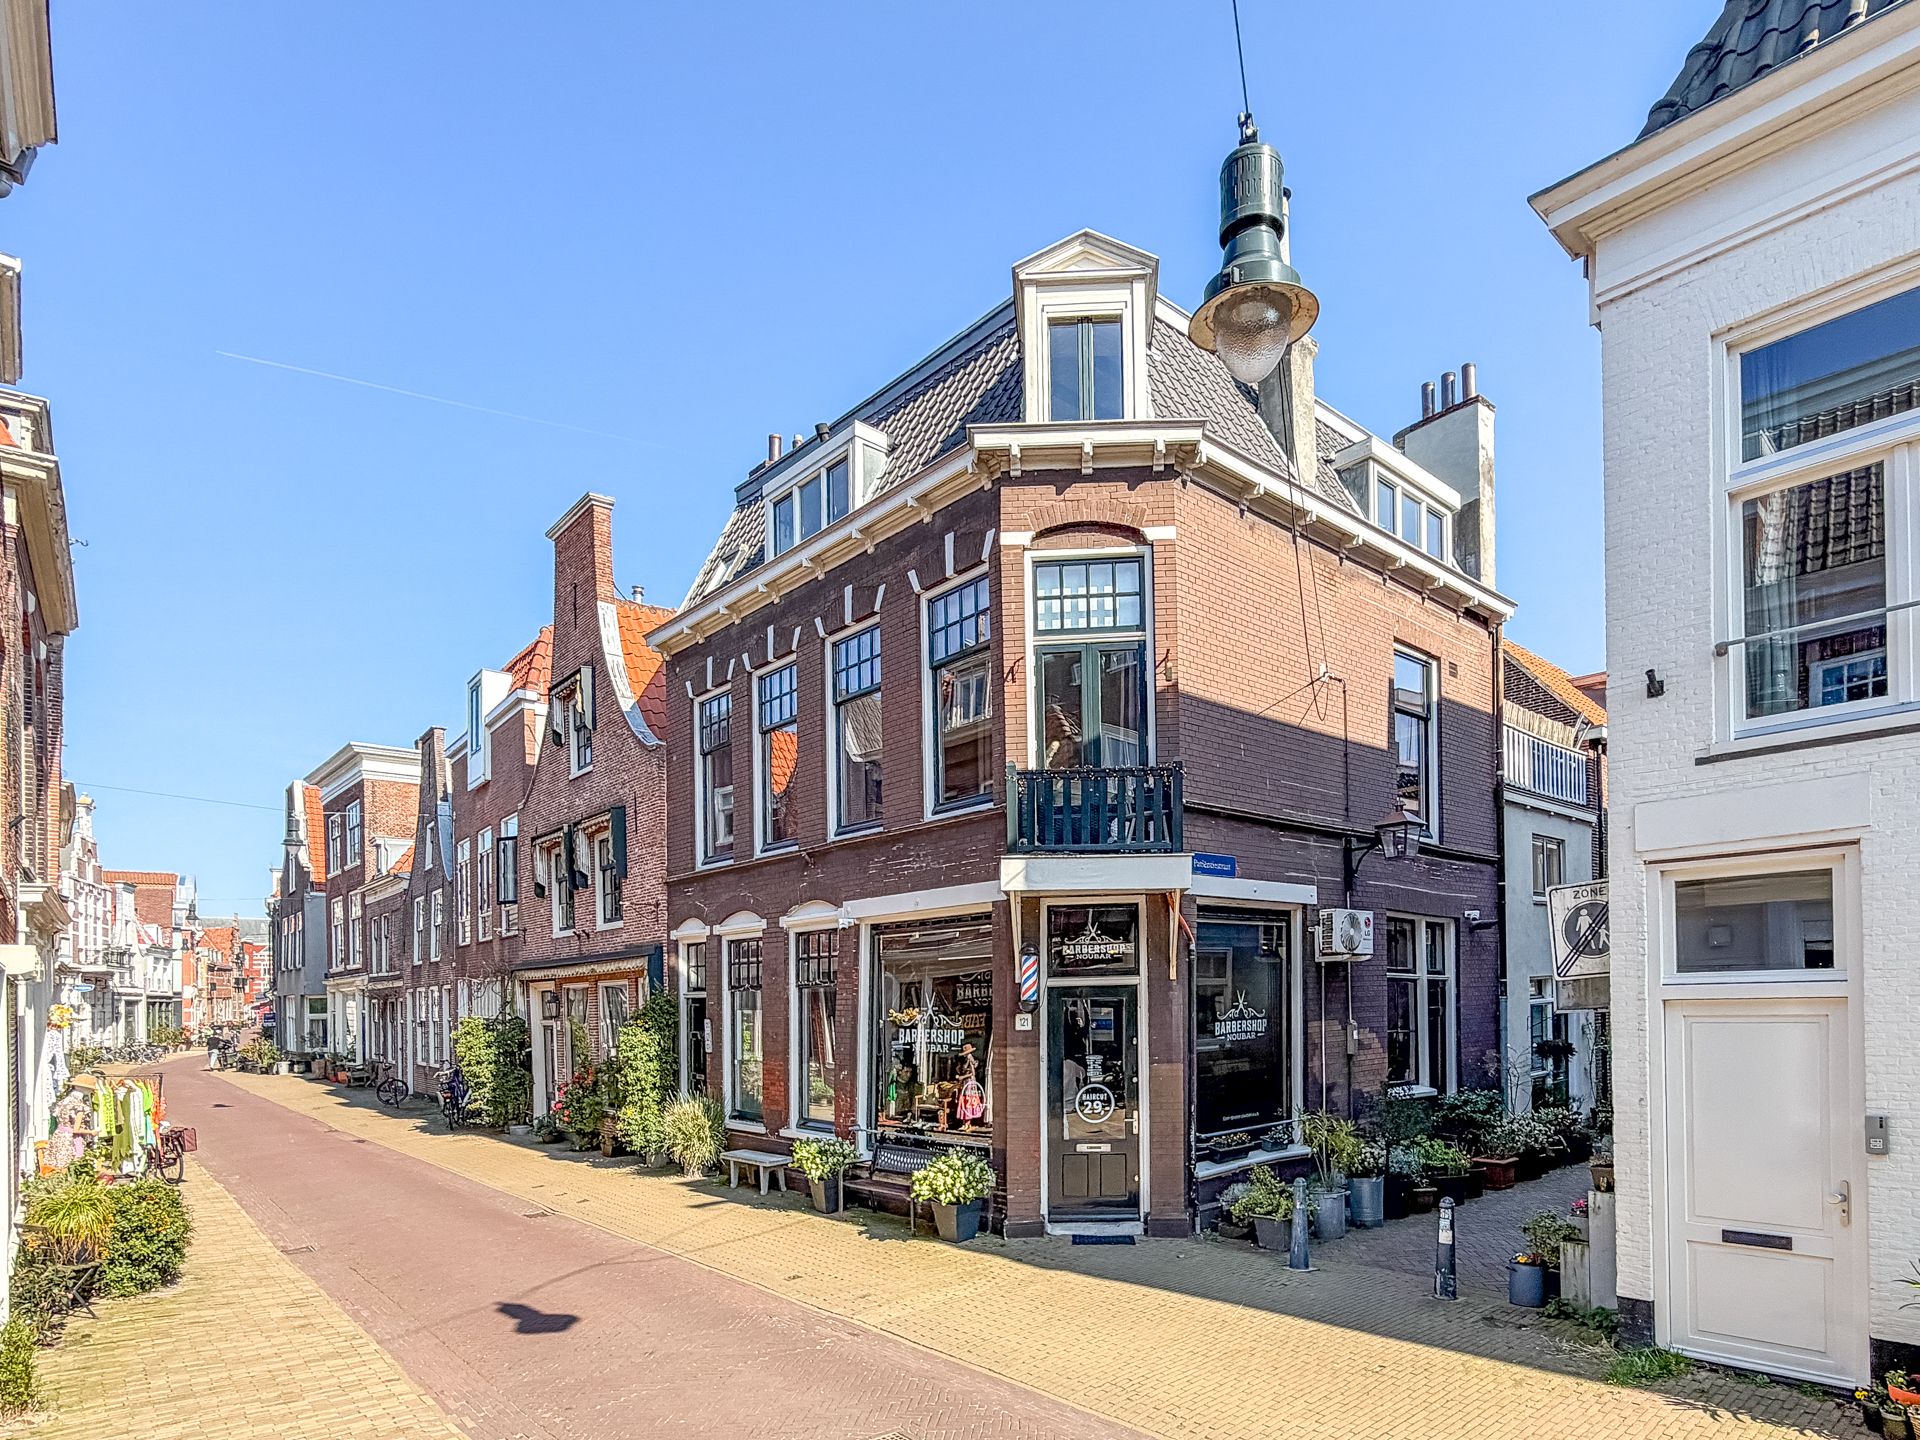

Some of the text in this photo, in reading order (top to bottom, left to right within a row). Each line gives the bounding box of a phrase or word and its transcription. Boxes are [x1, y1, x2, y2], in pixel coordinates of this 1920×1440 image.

[1573, 887, 1606, 900] ZONE
[1364, 929, 1371, 937] LG
[1062, 944, 1124, 955] BARBERSHOP
[1214, 1018, 1268, 1036] BARBERSHOP
[1226, 1032, 1256, 1041] NOUBAR
[1082, 1093, 1108, 1101] HAIRCUT
